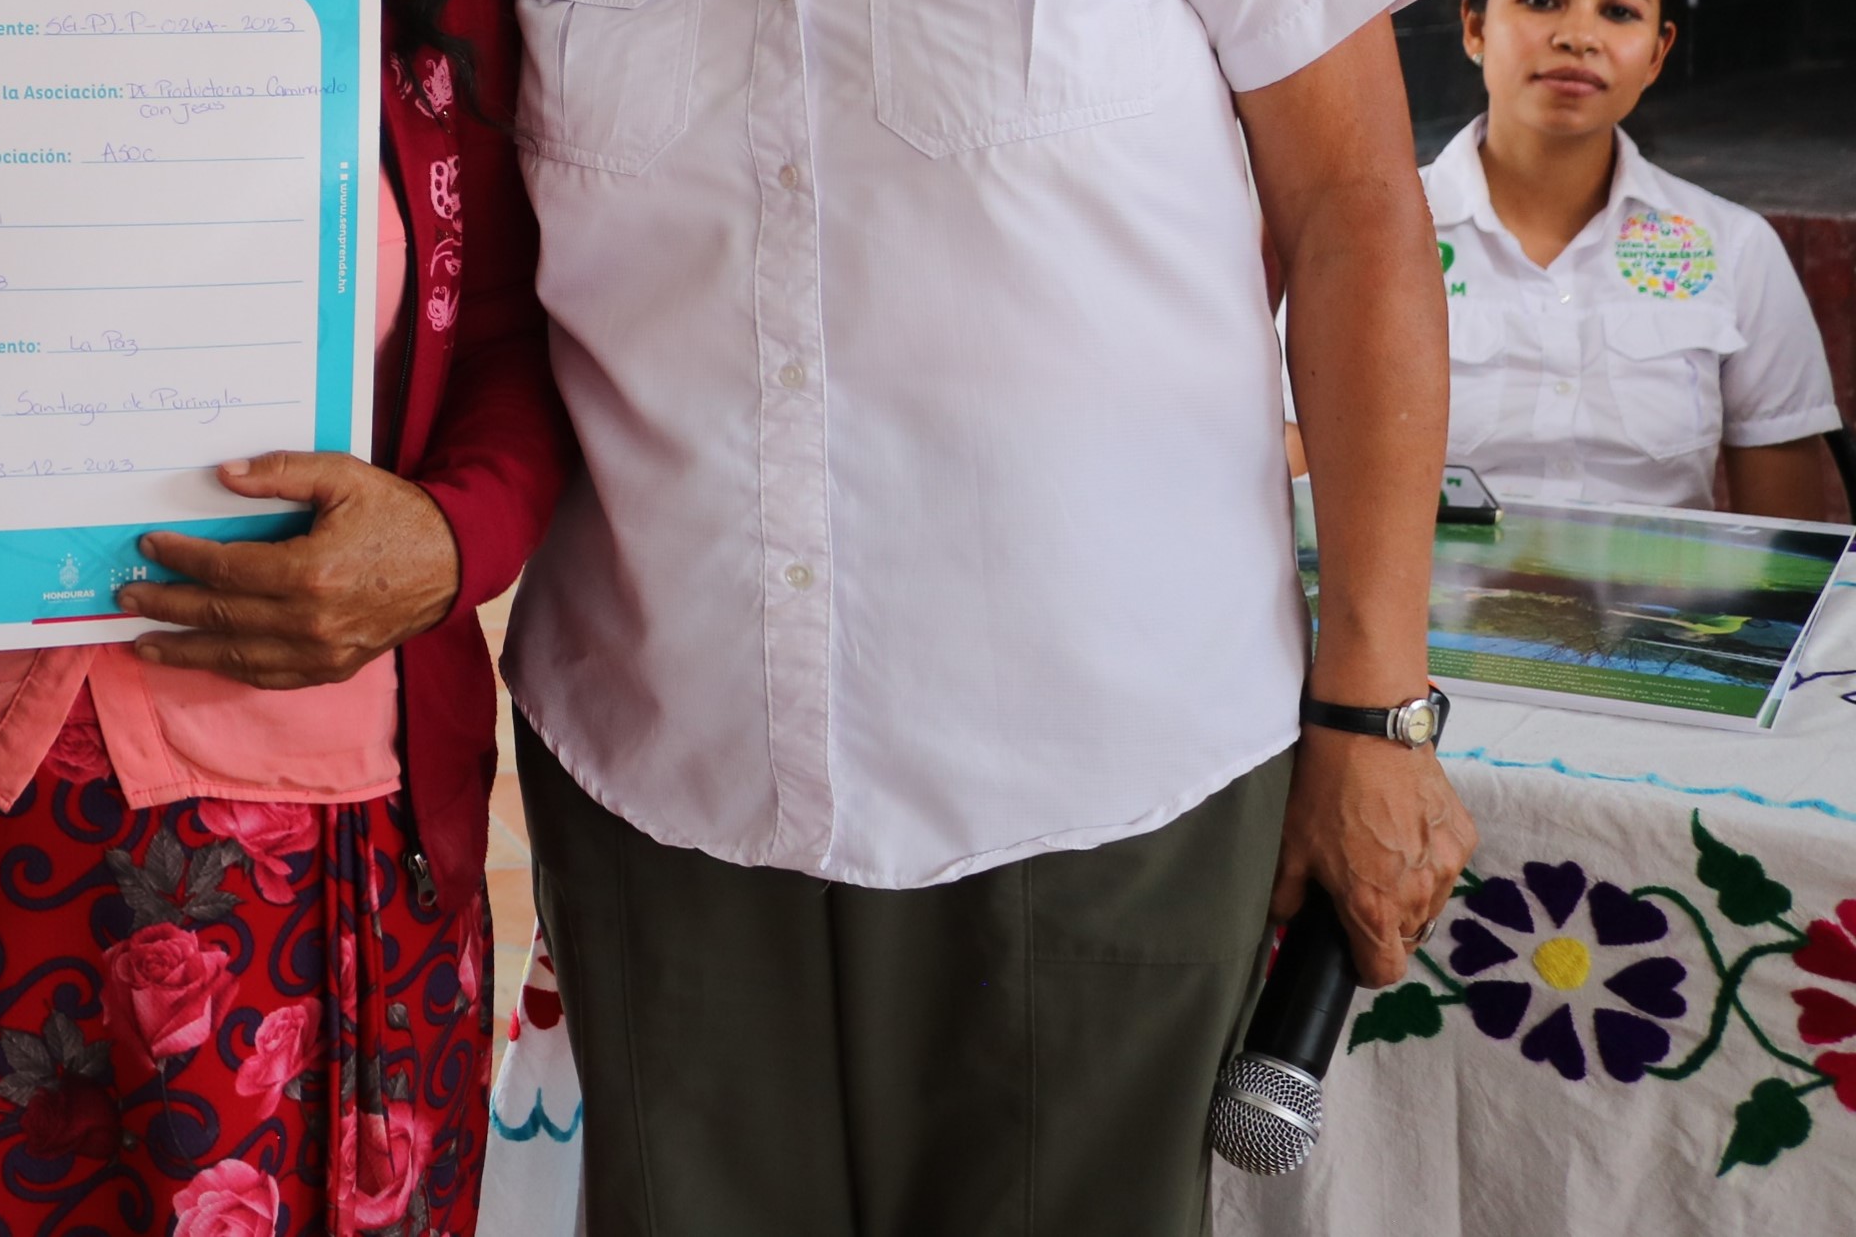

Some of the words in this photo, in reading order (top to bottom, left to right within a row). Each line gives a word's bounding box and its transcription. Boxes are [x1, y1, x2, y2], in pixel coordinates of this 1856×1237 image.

[2, 85, 19, 100] la
[24, 84, 124, 99] Asociación:
[337, 183, 348, 294] www.senprende.hn
[69, 335, 92, 352] La
[102, 330, 139, 357] Paz
[15, 390, 108, 427] Santiago
[43, 589, 95, 601] HONDURAS
